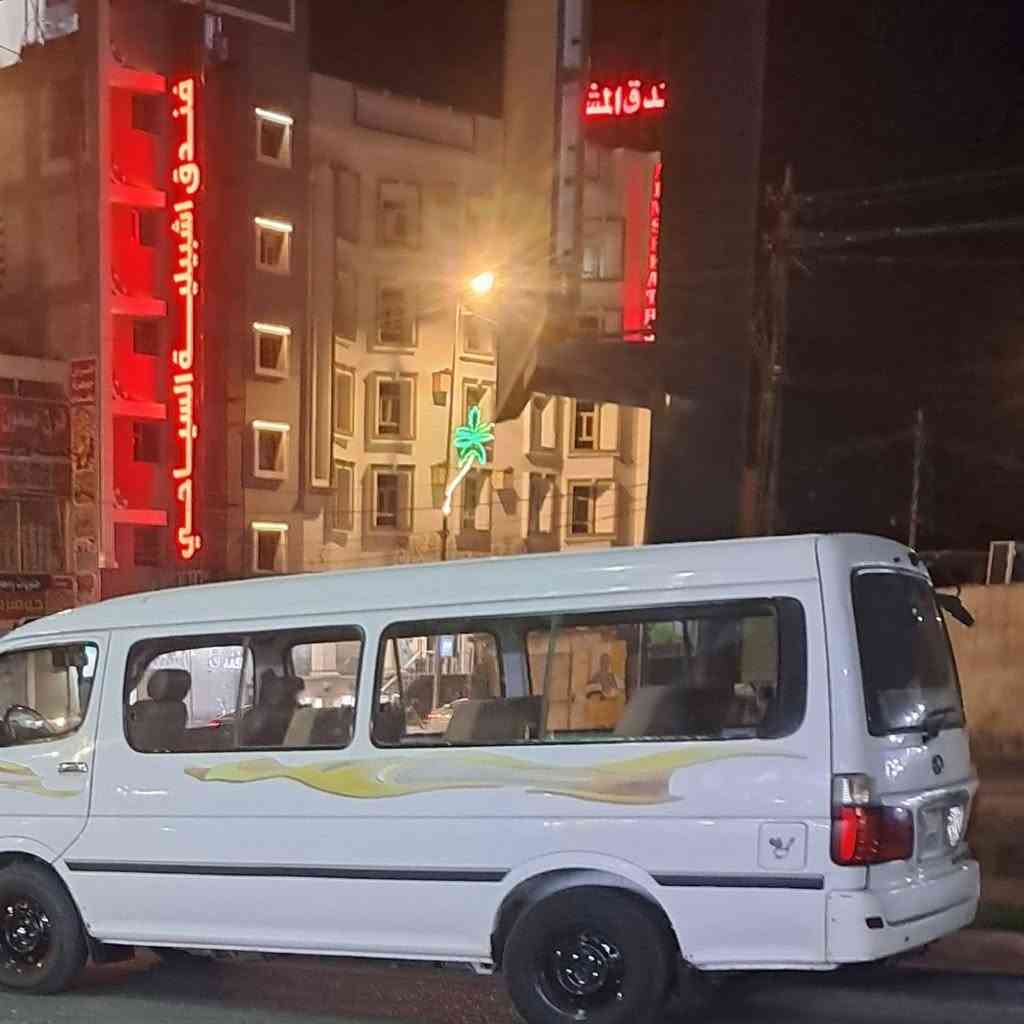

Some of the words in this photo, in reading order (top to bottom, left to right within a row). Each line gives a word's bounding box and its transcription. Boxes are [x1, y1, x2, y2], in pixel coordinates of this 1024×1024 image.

[172, 78, 201, 194] فندق
[622, 79, 666, 114] ندق
[172, 373, 202, 559] السياحي
